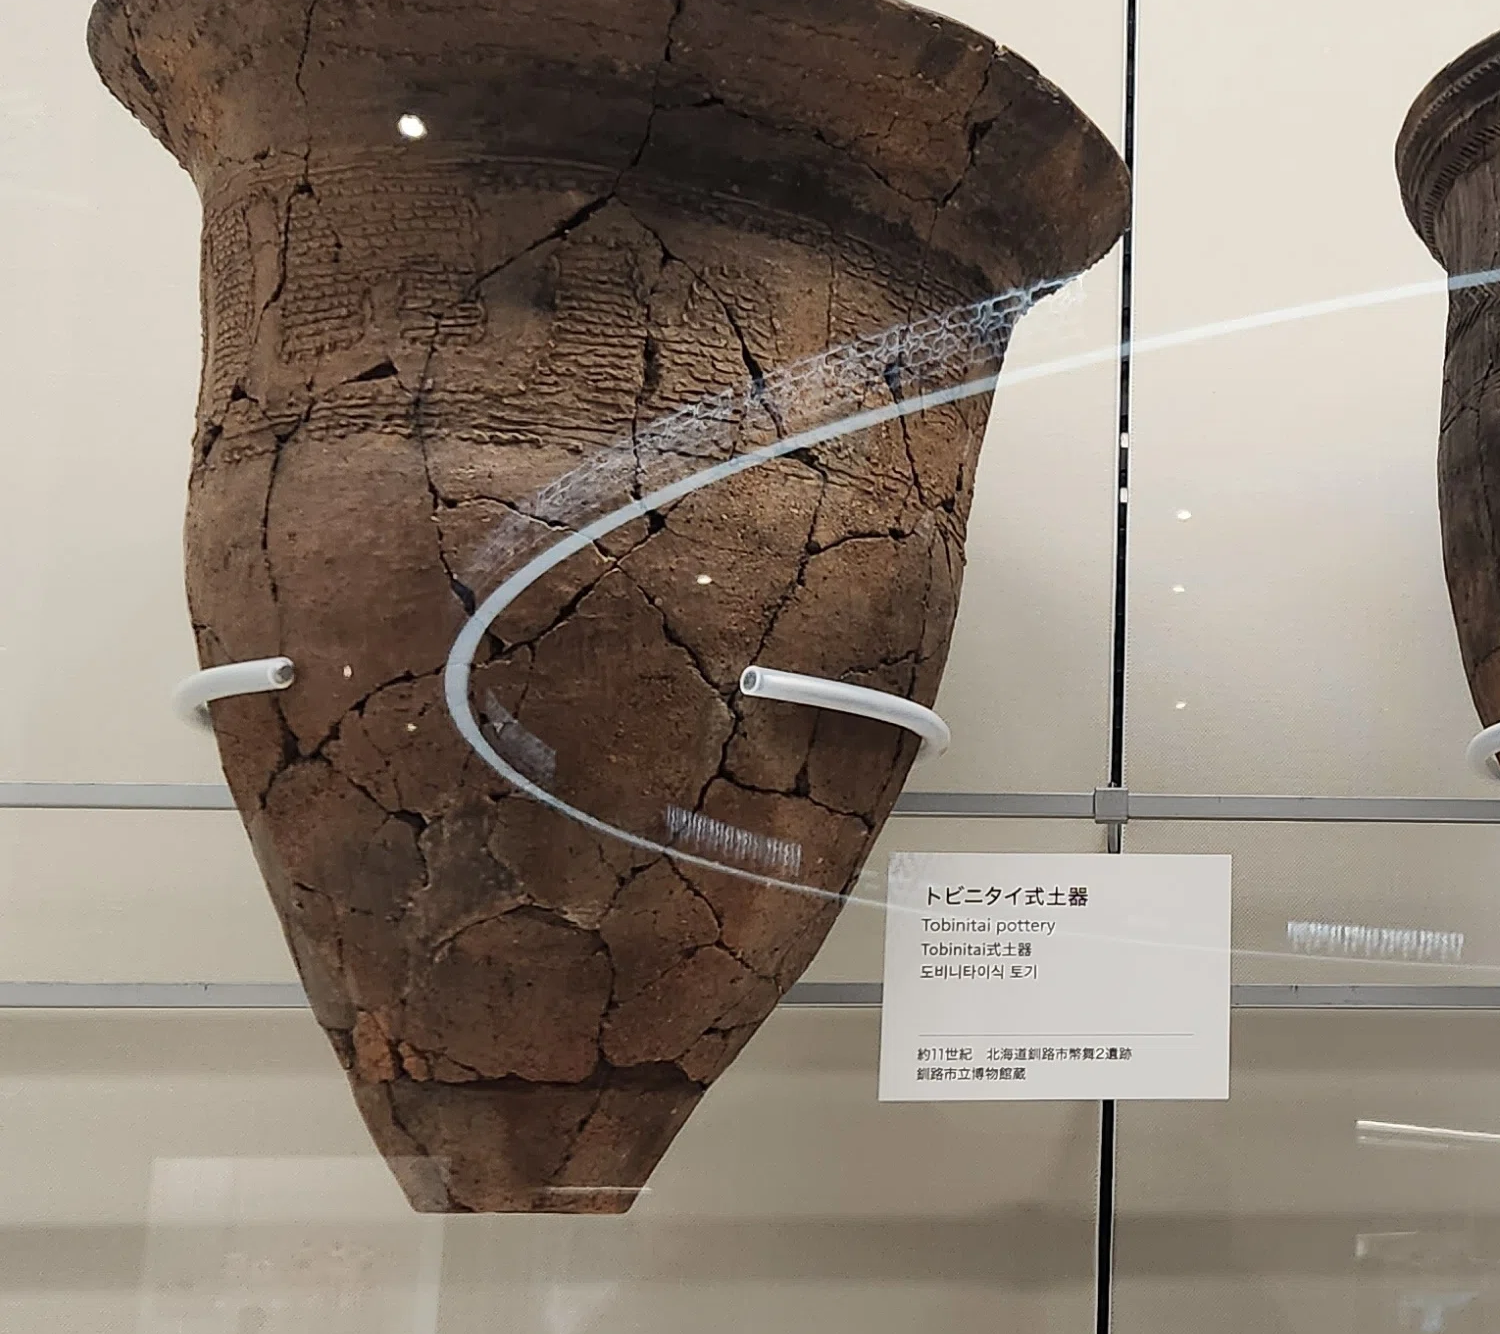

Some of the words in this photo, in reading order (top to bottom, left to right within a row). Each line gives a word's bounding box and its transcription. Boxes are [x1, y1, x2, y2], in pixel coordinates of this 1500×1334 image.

[928, 886, 1088, 907] トビニタイ式土器
[922, 918, 991, 933] Tobinitai
[996, 920, 1056, 936] pottery
[921, 942, 1032, 957] Tobinitai式土器
[1010, 965, 1038, 979] 토기
[917, 1047, 973, 1061] 約11世紀
[917, 1067, 1026, 1081] 釧路市立博物館蔵
